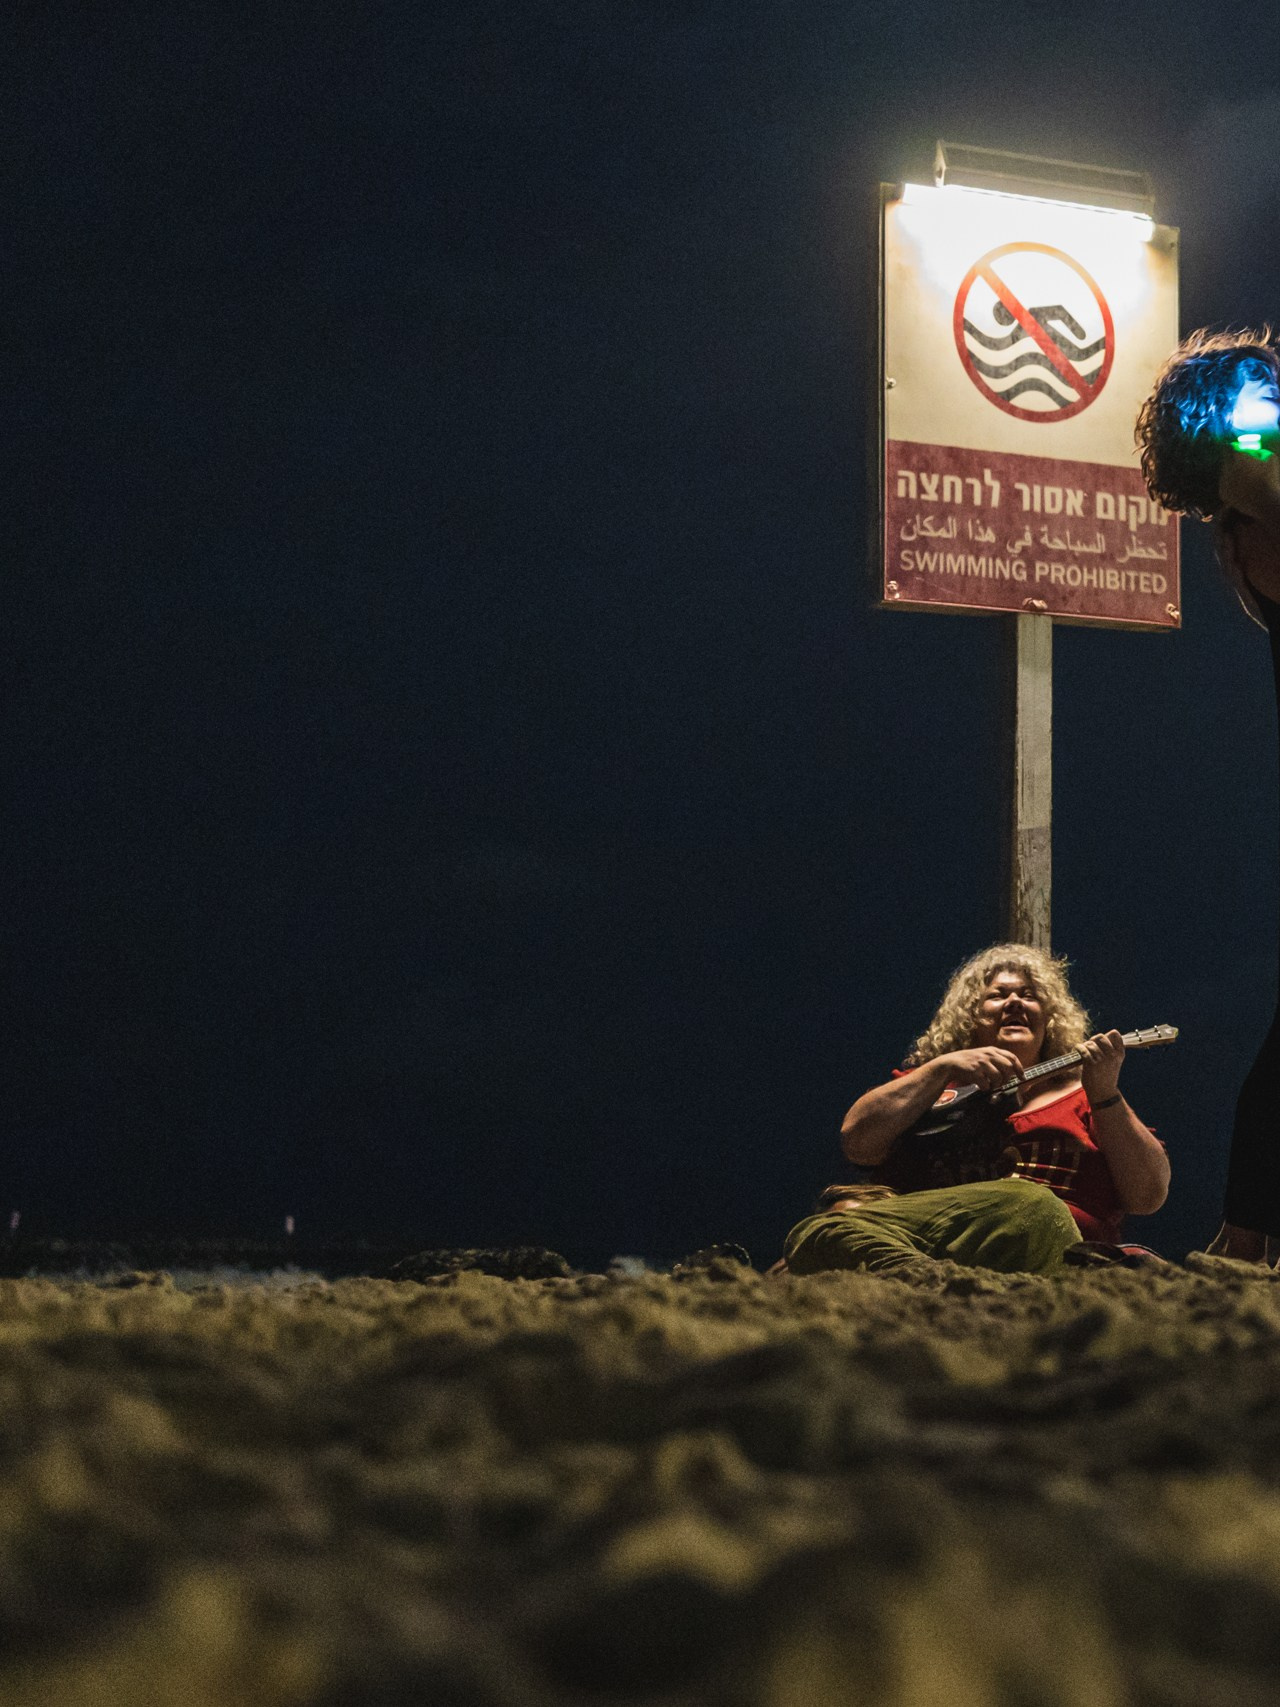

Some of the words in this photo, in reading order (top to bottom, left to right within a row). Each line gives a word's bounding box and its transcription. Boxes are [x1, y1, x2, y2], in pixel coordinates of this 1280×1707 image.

[897, 468, 1000, 508] לרחצה
[1014, 482, 1084, 518] אסור
[900, 514, 957, 541] المكان
[1096, 490, 1169, 532] מקום
[967, 518, 996, 543] هذا
[1006, 524, 1033, 558] في
[1039, 524, 1106, 556] السباحة
[900, 549, 1027, 581] SWIMMING
[1035, 560, 1168, 594] PROHIBITED
